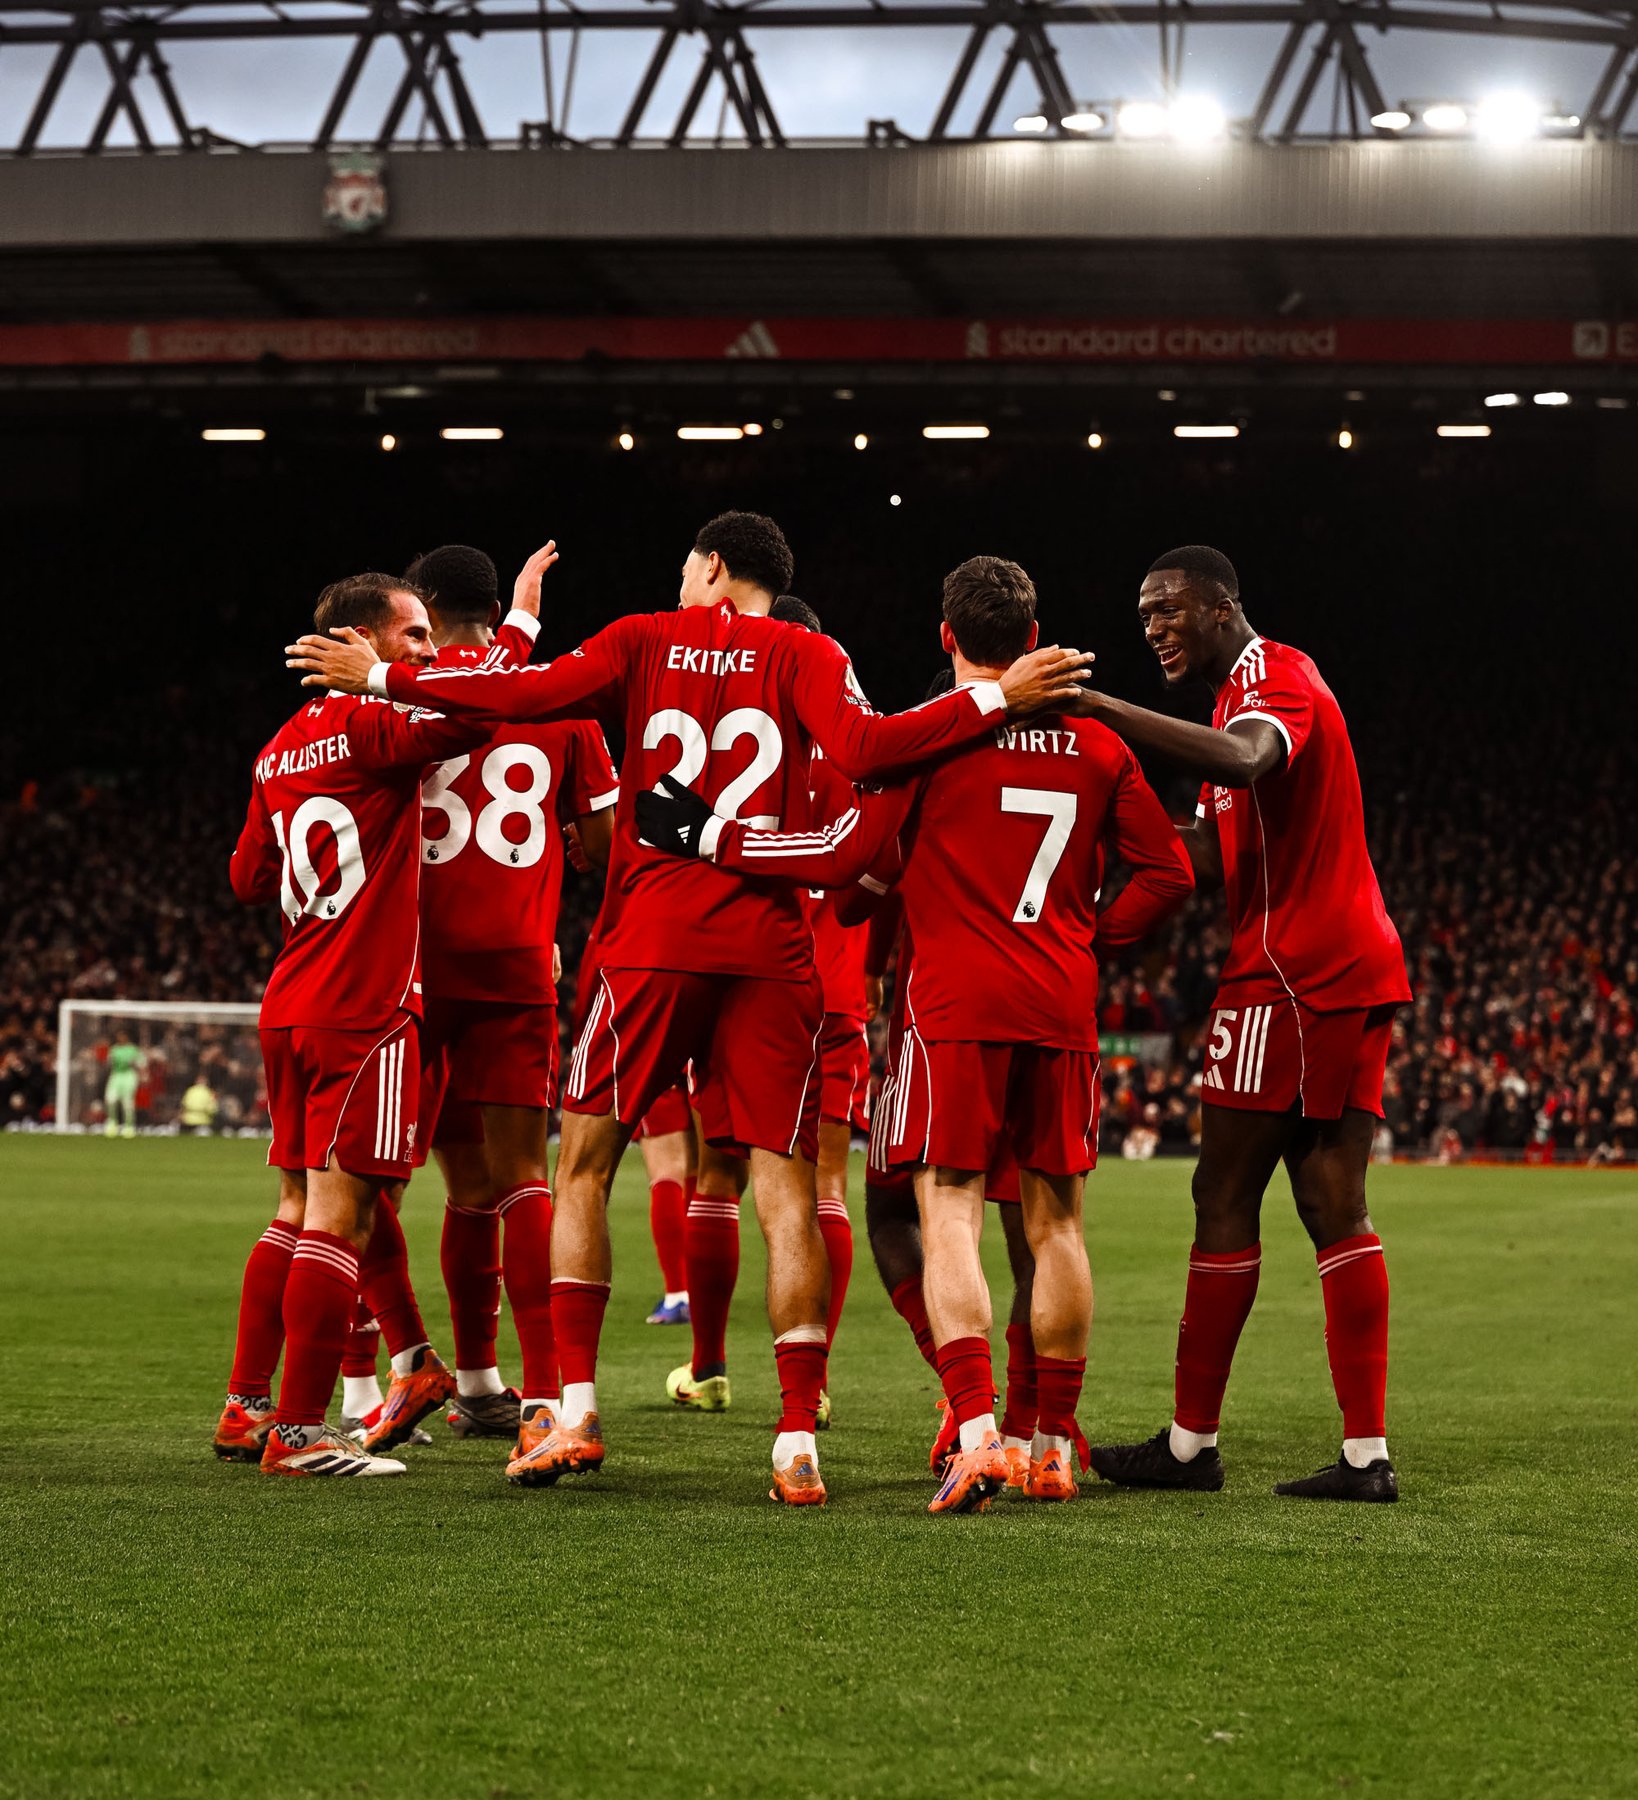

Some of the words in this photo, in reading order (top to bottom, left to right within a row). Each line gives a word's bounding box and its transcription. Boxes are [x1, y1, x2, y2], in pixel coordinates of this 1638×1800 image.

[999, 326, 1159, 355] standard
[1164, 326, 1337, 356] chartered
[276, 733, 351, 777] ALLISTER
[638, 707, 783, 847] 22
[996, 727, 1080, 756] WIRTZ
[421, 743, 551, 868] 38
[271, 796, 366, 927] 10
[1001, 786, 1078, 923] 7
[1208, 1009, 1238, 1060] 5
